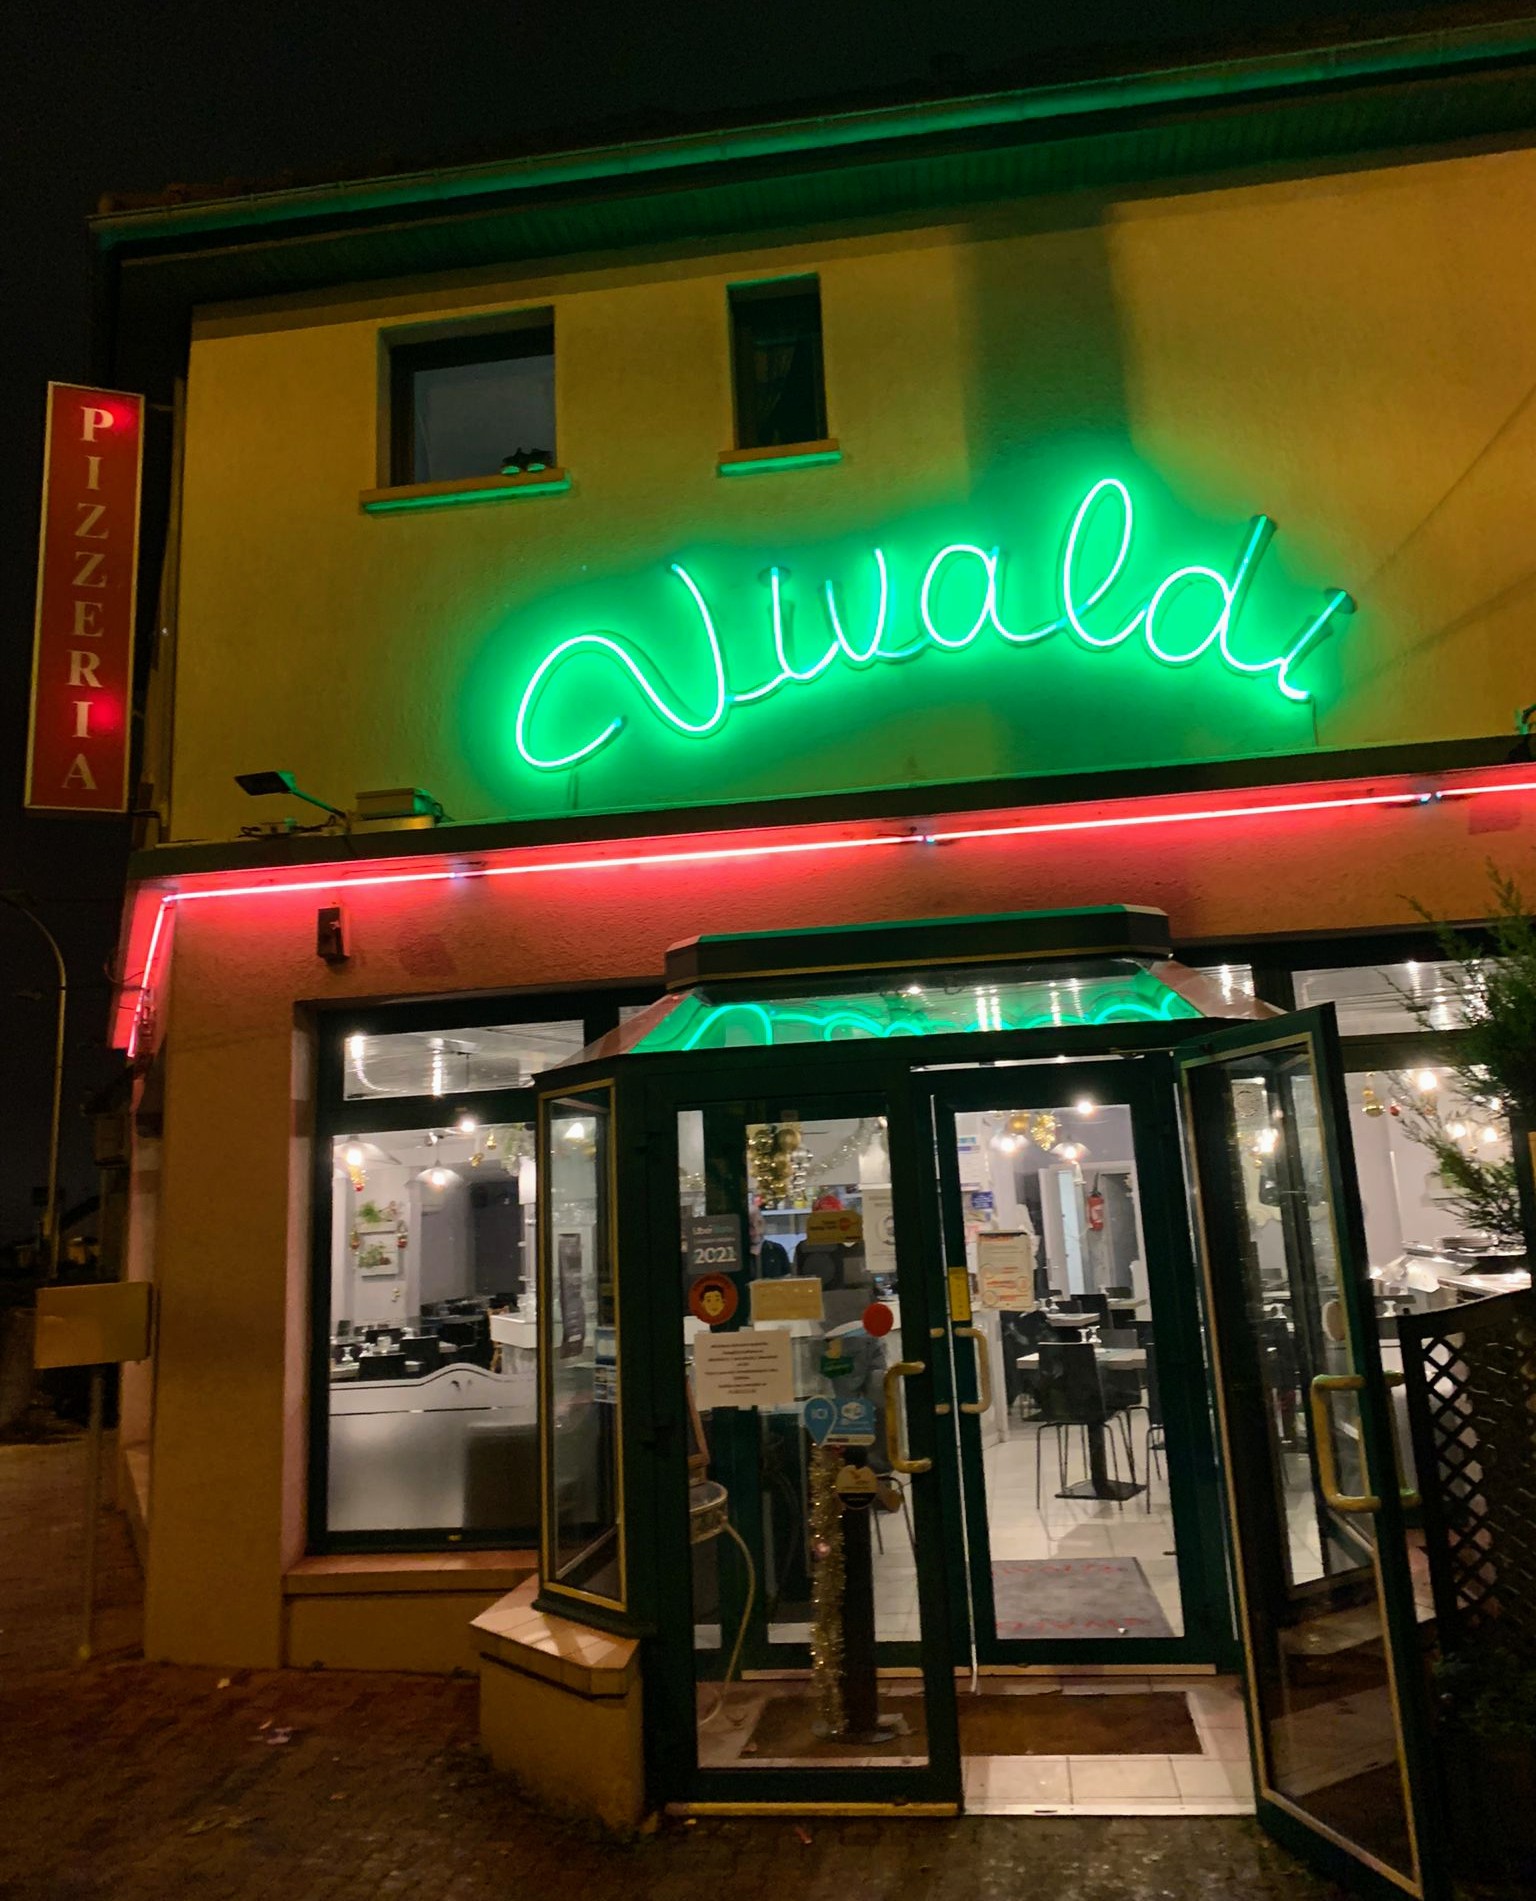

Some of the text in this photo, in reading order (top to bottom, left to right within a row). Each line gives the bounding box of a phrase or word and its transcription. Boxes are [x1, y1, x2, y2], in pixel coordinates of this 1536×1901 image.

[61, 406, 115, 790] PIZZERIA
[514, 476, 1352, 770] Vivaldi
[694, 1246, 737, 1264] 2021
